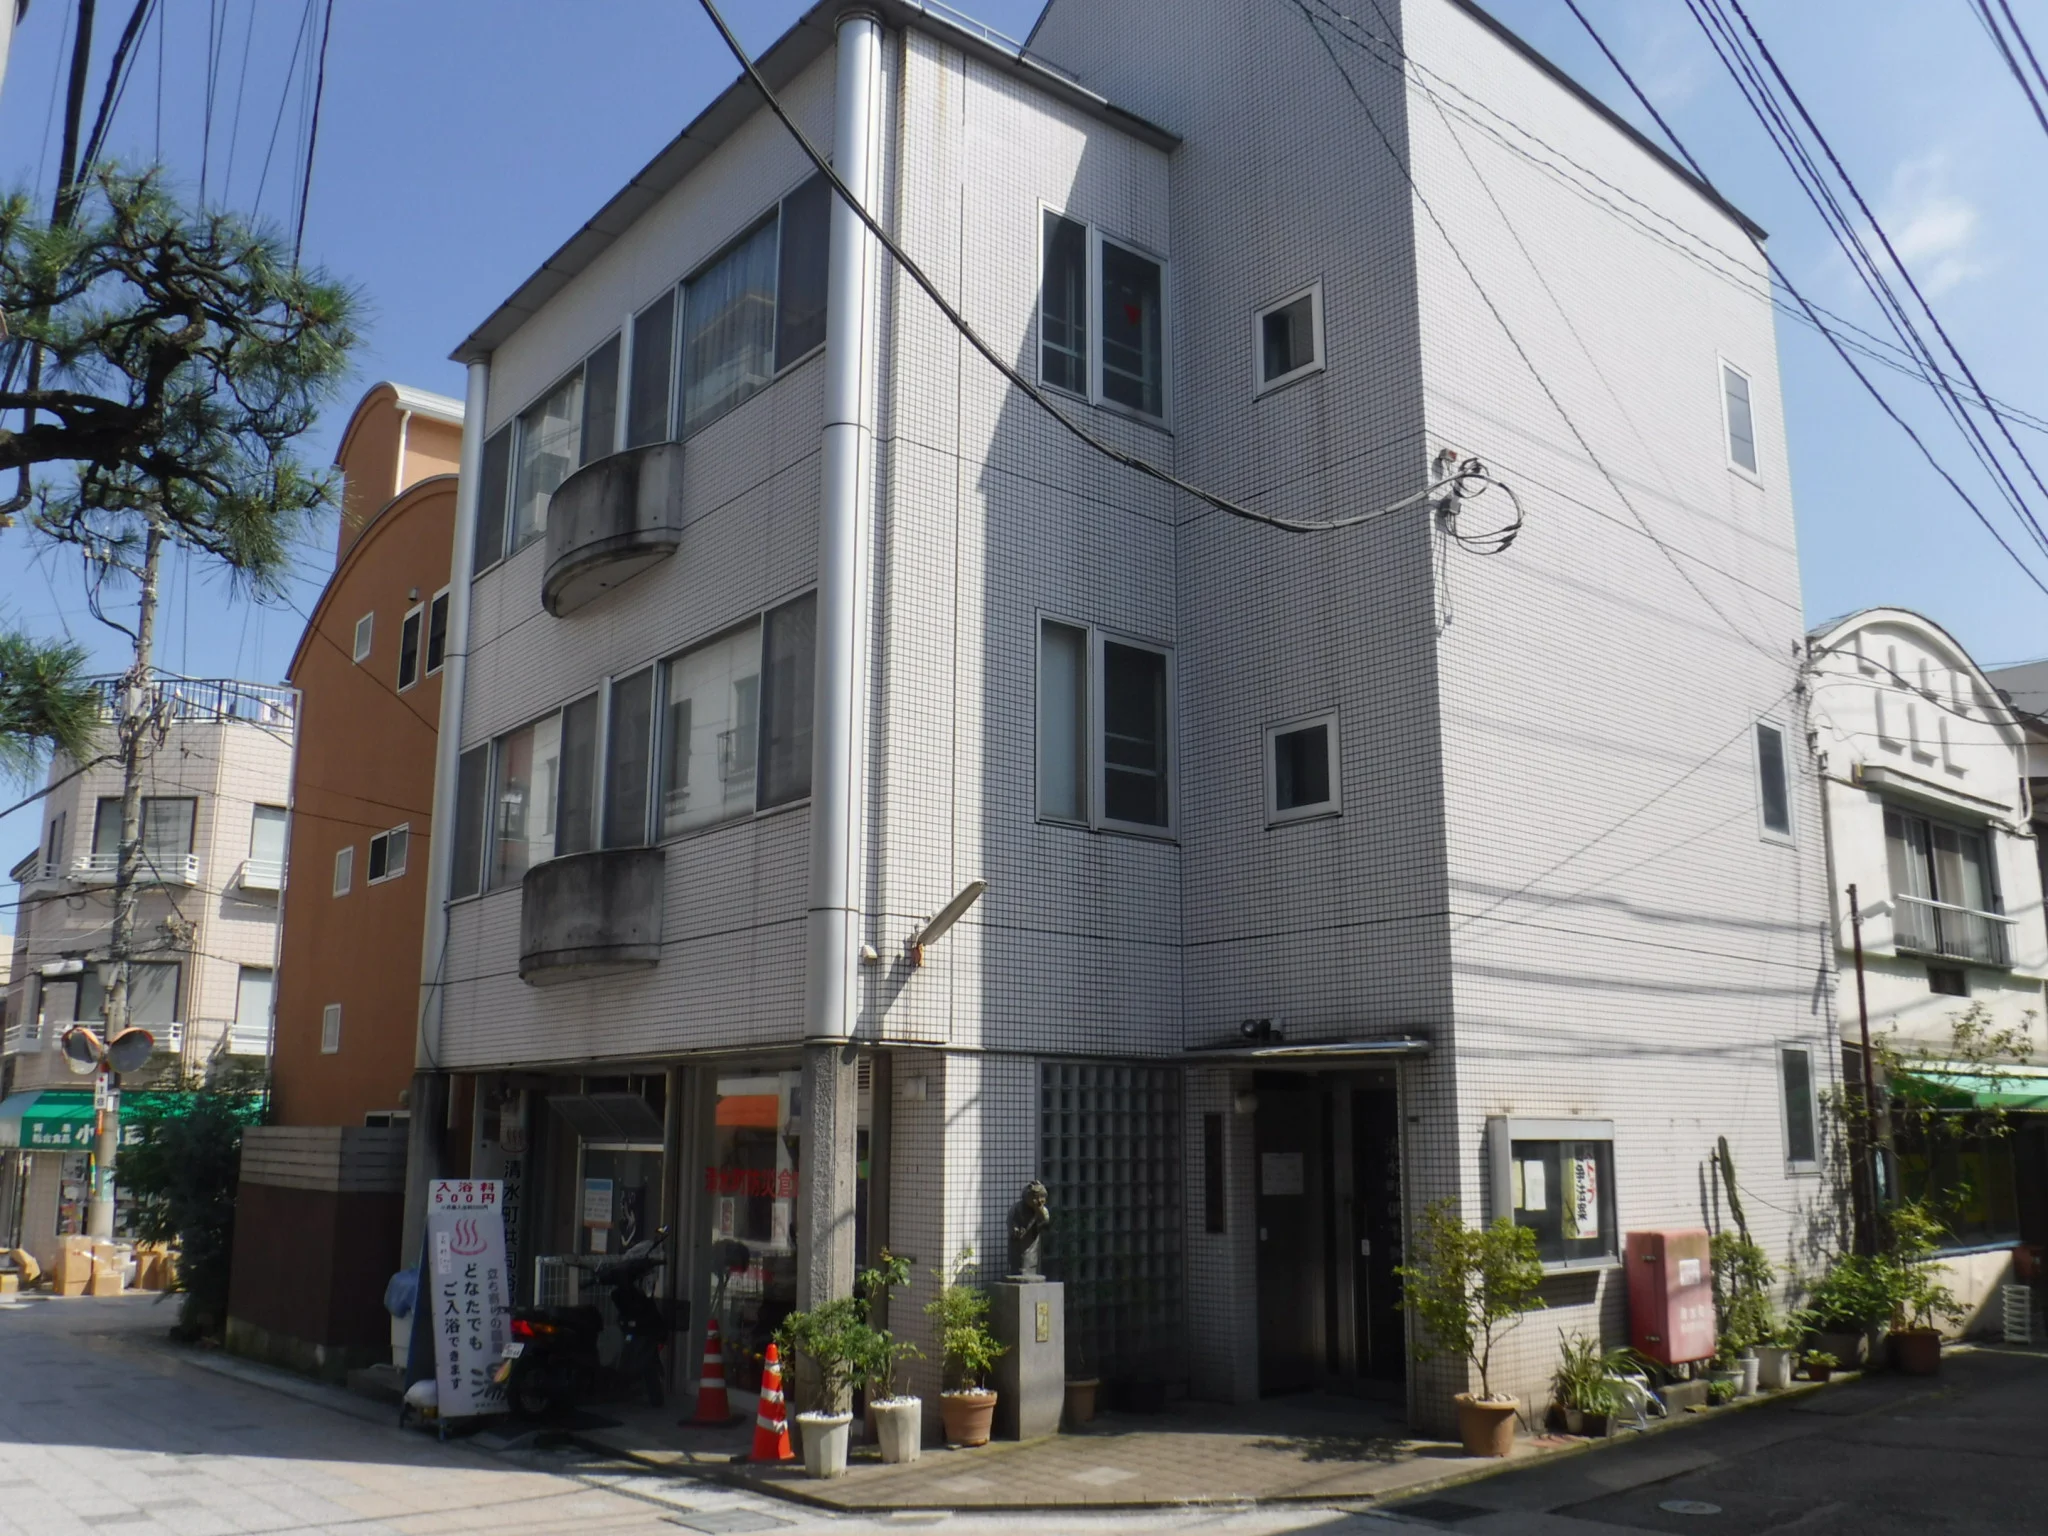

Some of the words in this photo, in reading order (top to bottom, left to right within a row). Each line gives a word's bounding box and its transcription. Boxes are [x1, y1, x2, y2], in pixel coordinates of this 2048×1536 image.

[435, 1193, 495, 1204] 500円
[436, 1181, 495, 1193] 入浴料
[463, 1263, 482, 1351] どなたでも
[443, 1281, 462, 1390] ご入浴できます
